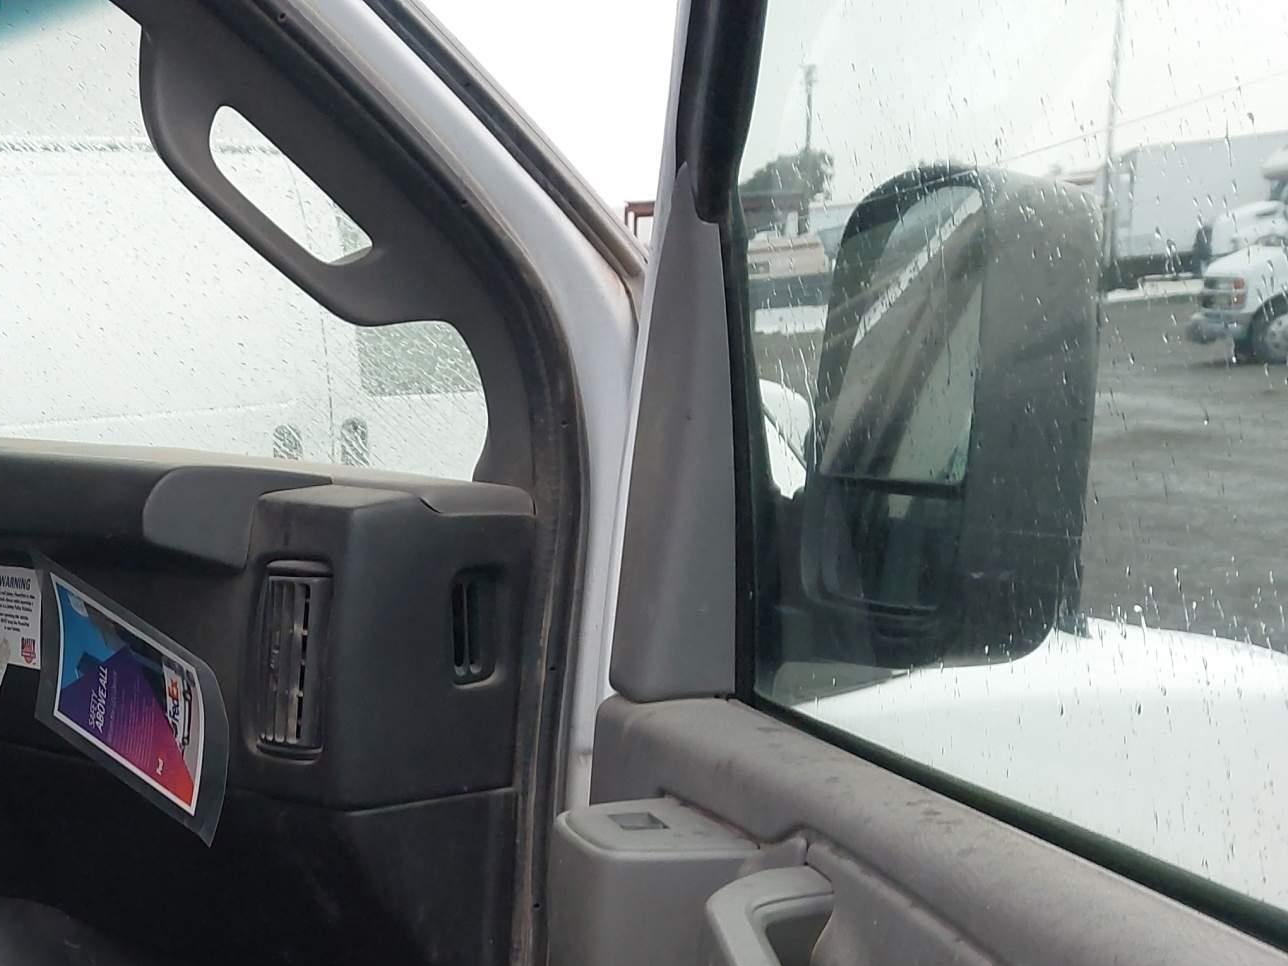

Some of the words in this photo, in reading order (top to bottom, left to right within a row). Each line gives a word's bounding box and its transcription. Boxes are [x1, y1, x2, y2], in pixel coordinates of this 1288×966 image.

[0, 575, 31, 591] WARNING
[99, 665, 108, 689] ALL
[89, 688, 98, 729] SAFETY
[95, 686, 107, 734] ABOVE
[168, 678, 180, 722] FedEx
